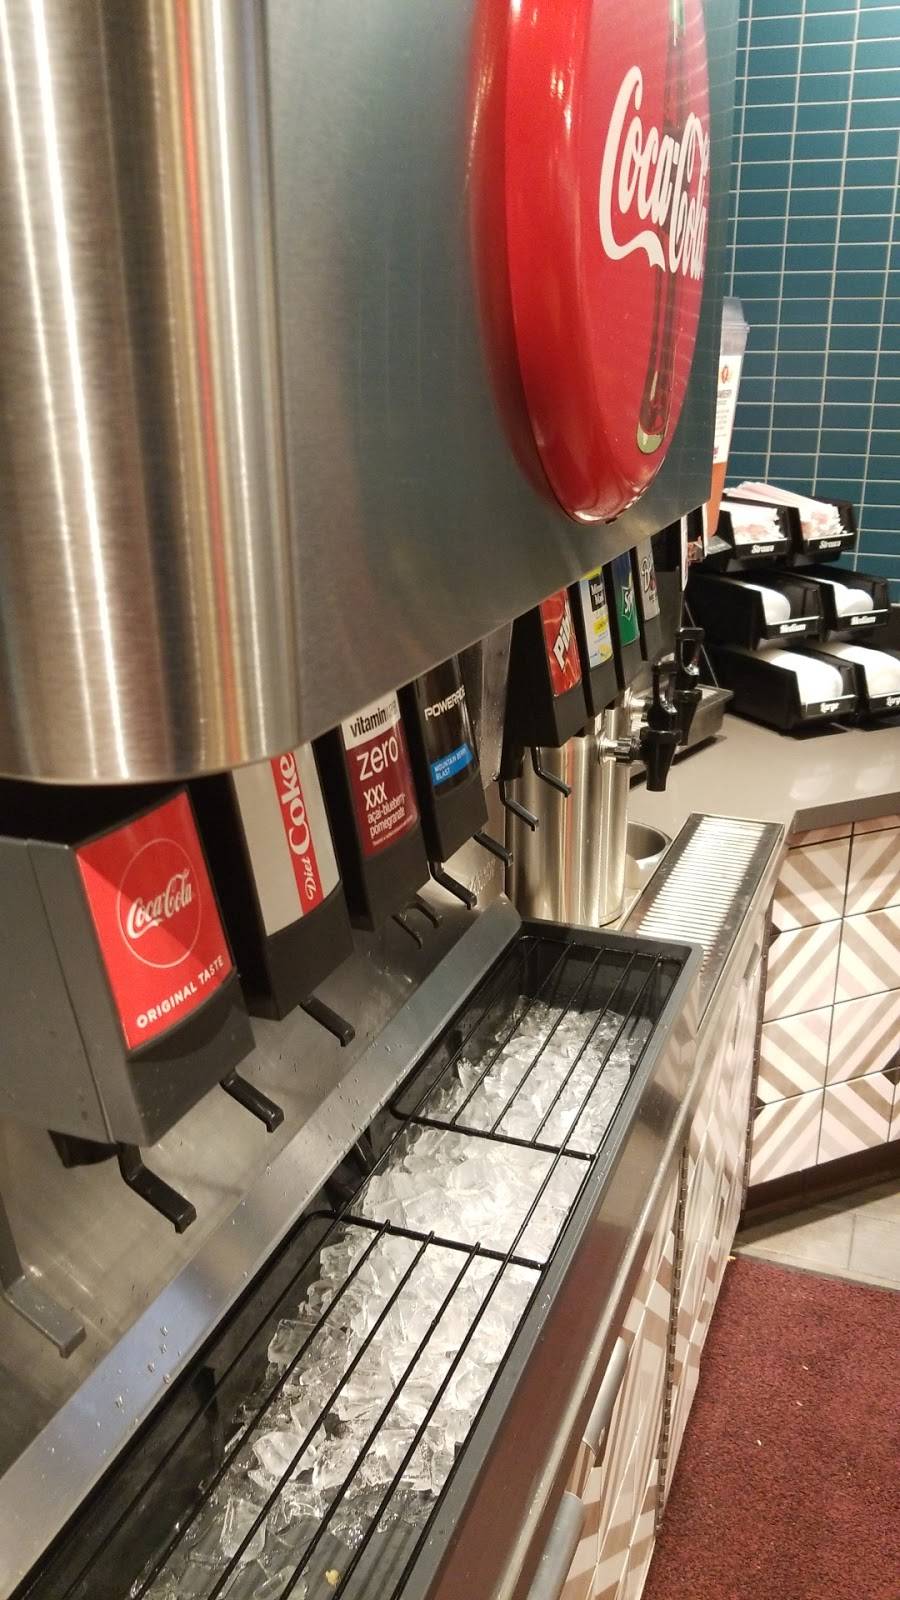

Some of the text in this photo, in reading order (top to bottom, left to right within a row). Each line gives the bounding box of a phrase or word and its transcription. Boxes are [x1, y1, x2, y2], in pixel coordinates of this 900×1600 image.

[356, 736, 399, 782] zero
[279, 752, 317, 901] Diet Coke
[136, 955, 225, 1030] ORIGINAL TASTE
